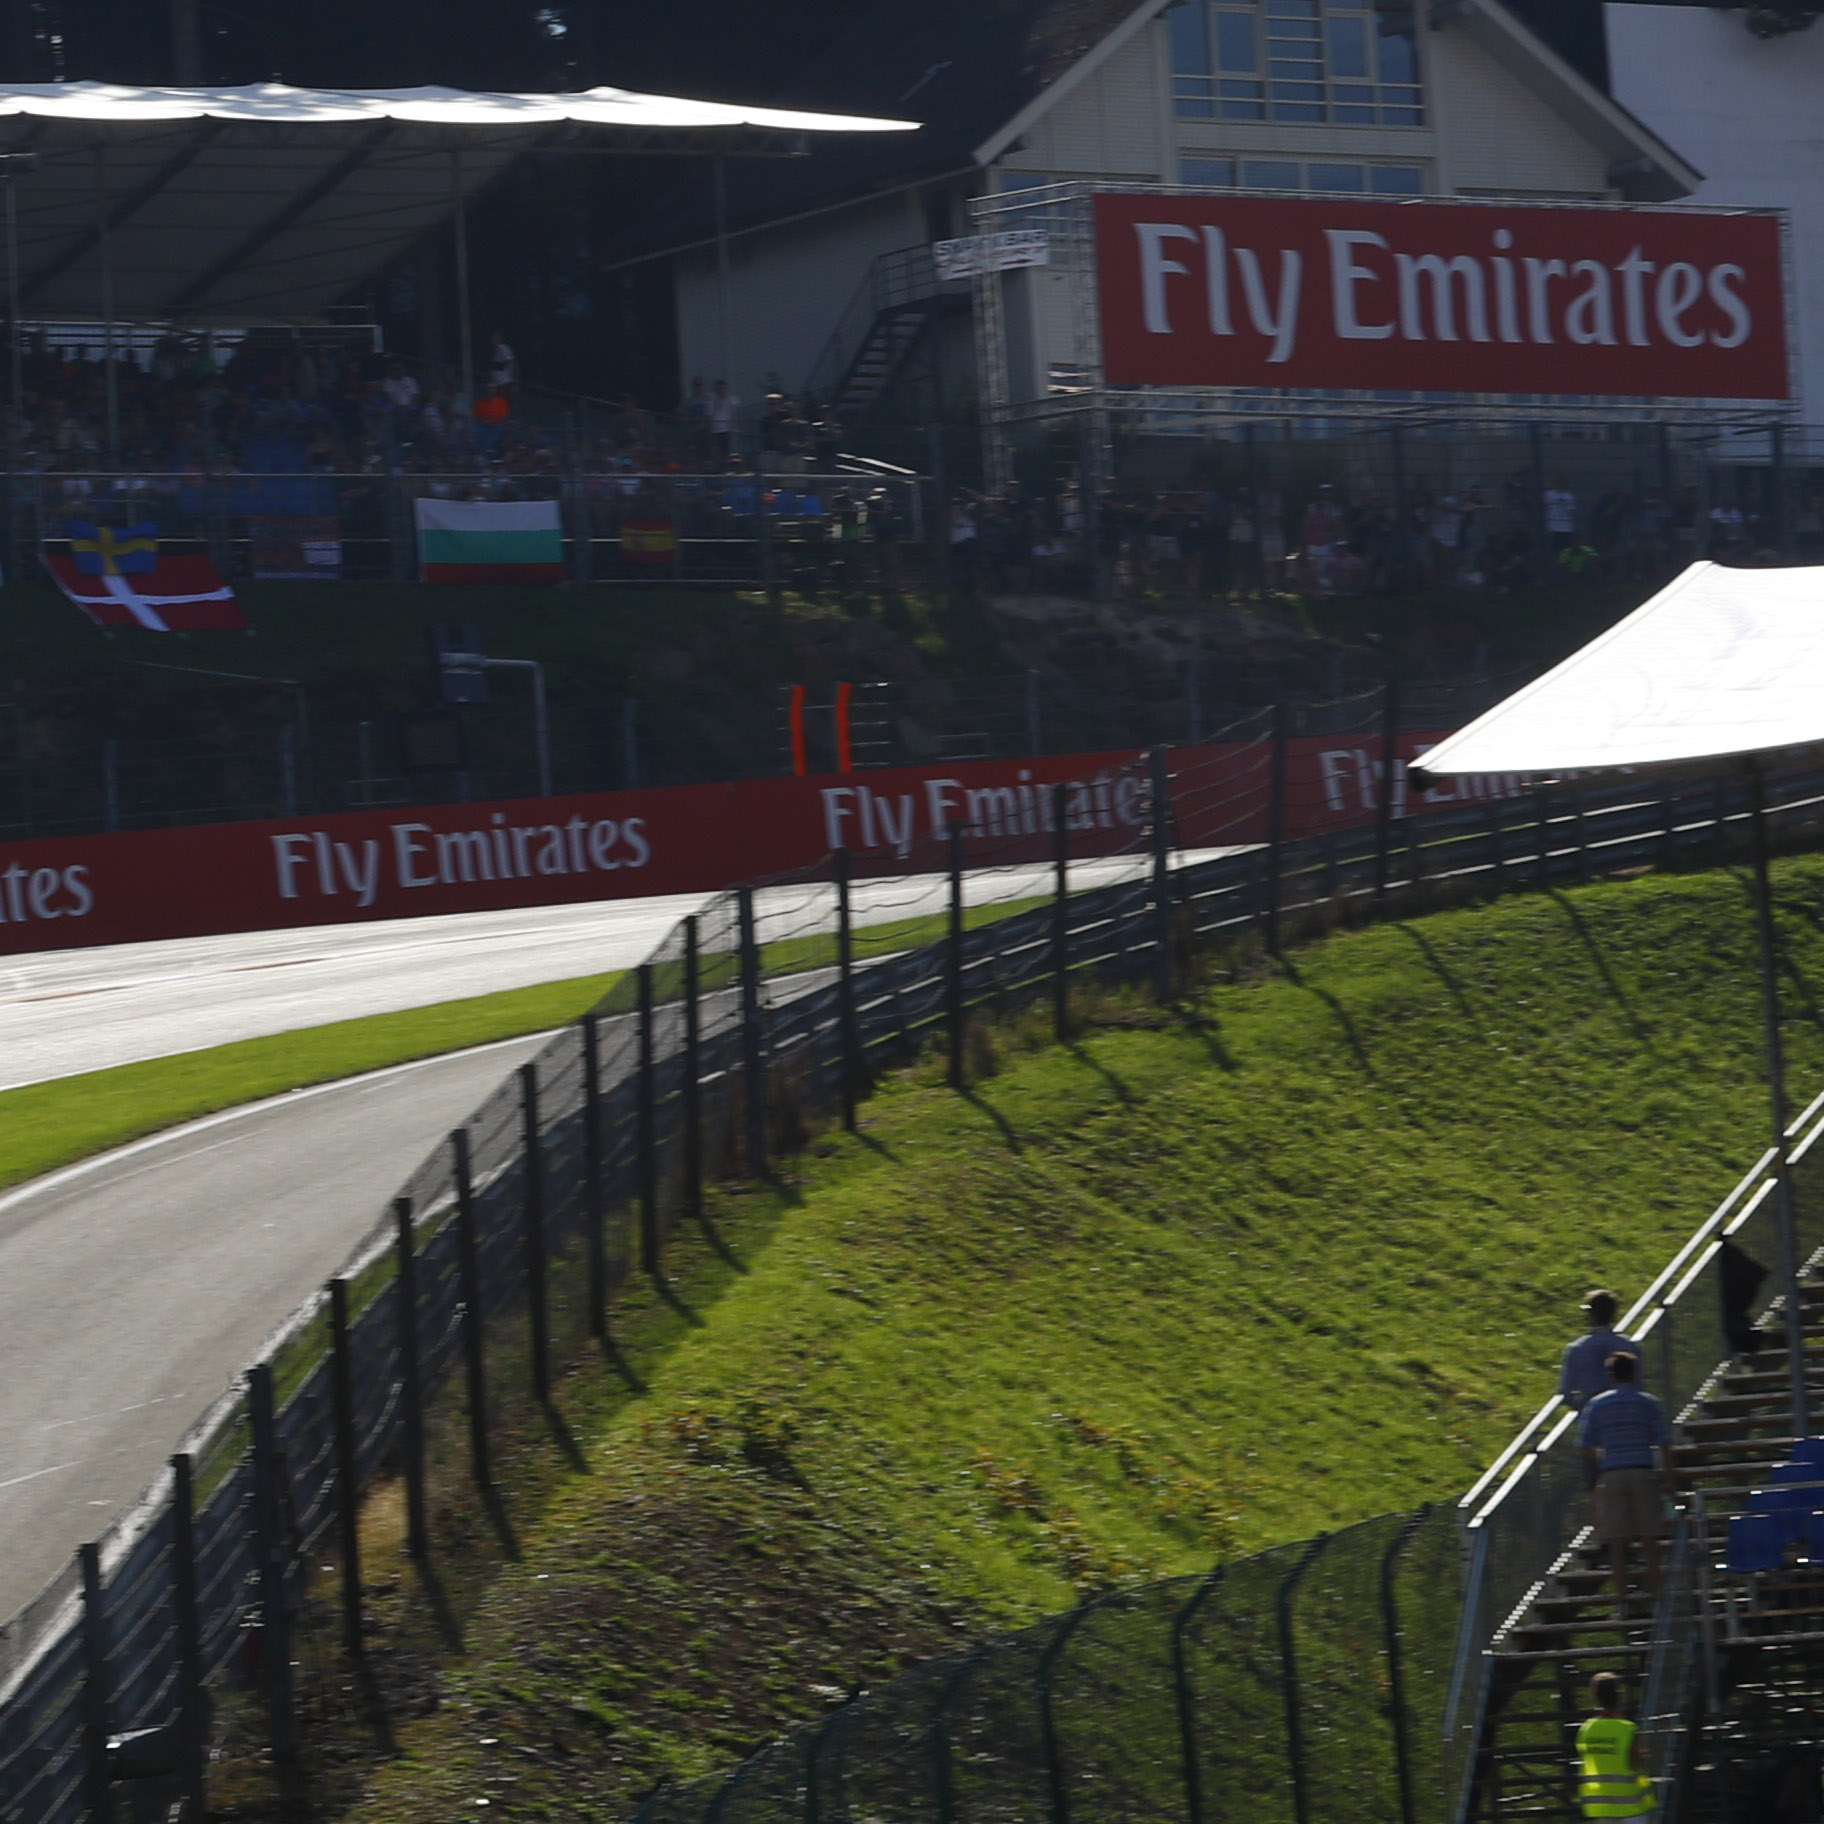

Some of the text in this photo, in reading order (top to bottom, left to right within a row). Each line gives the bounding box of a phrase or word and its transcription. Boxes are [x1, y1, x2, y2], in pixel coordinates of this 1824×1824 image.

[1133, 223, 1753, 363] Fly Emirates
[270, 811, 651, 907] Fly Emirates
[820, 769, 1170, 860] Fly Emirate
